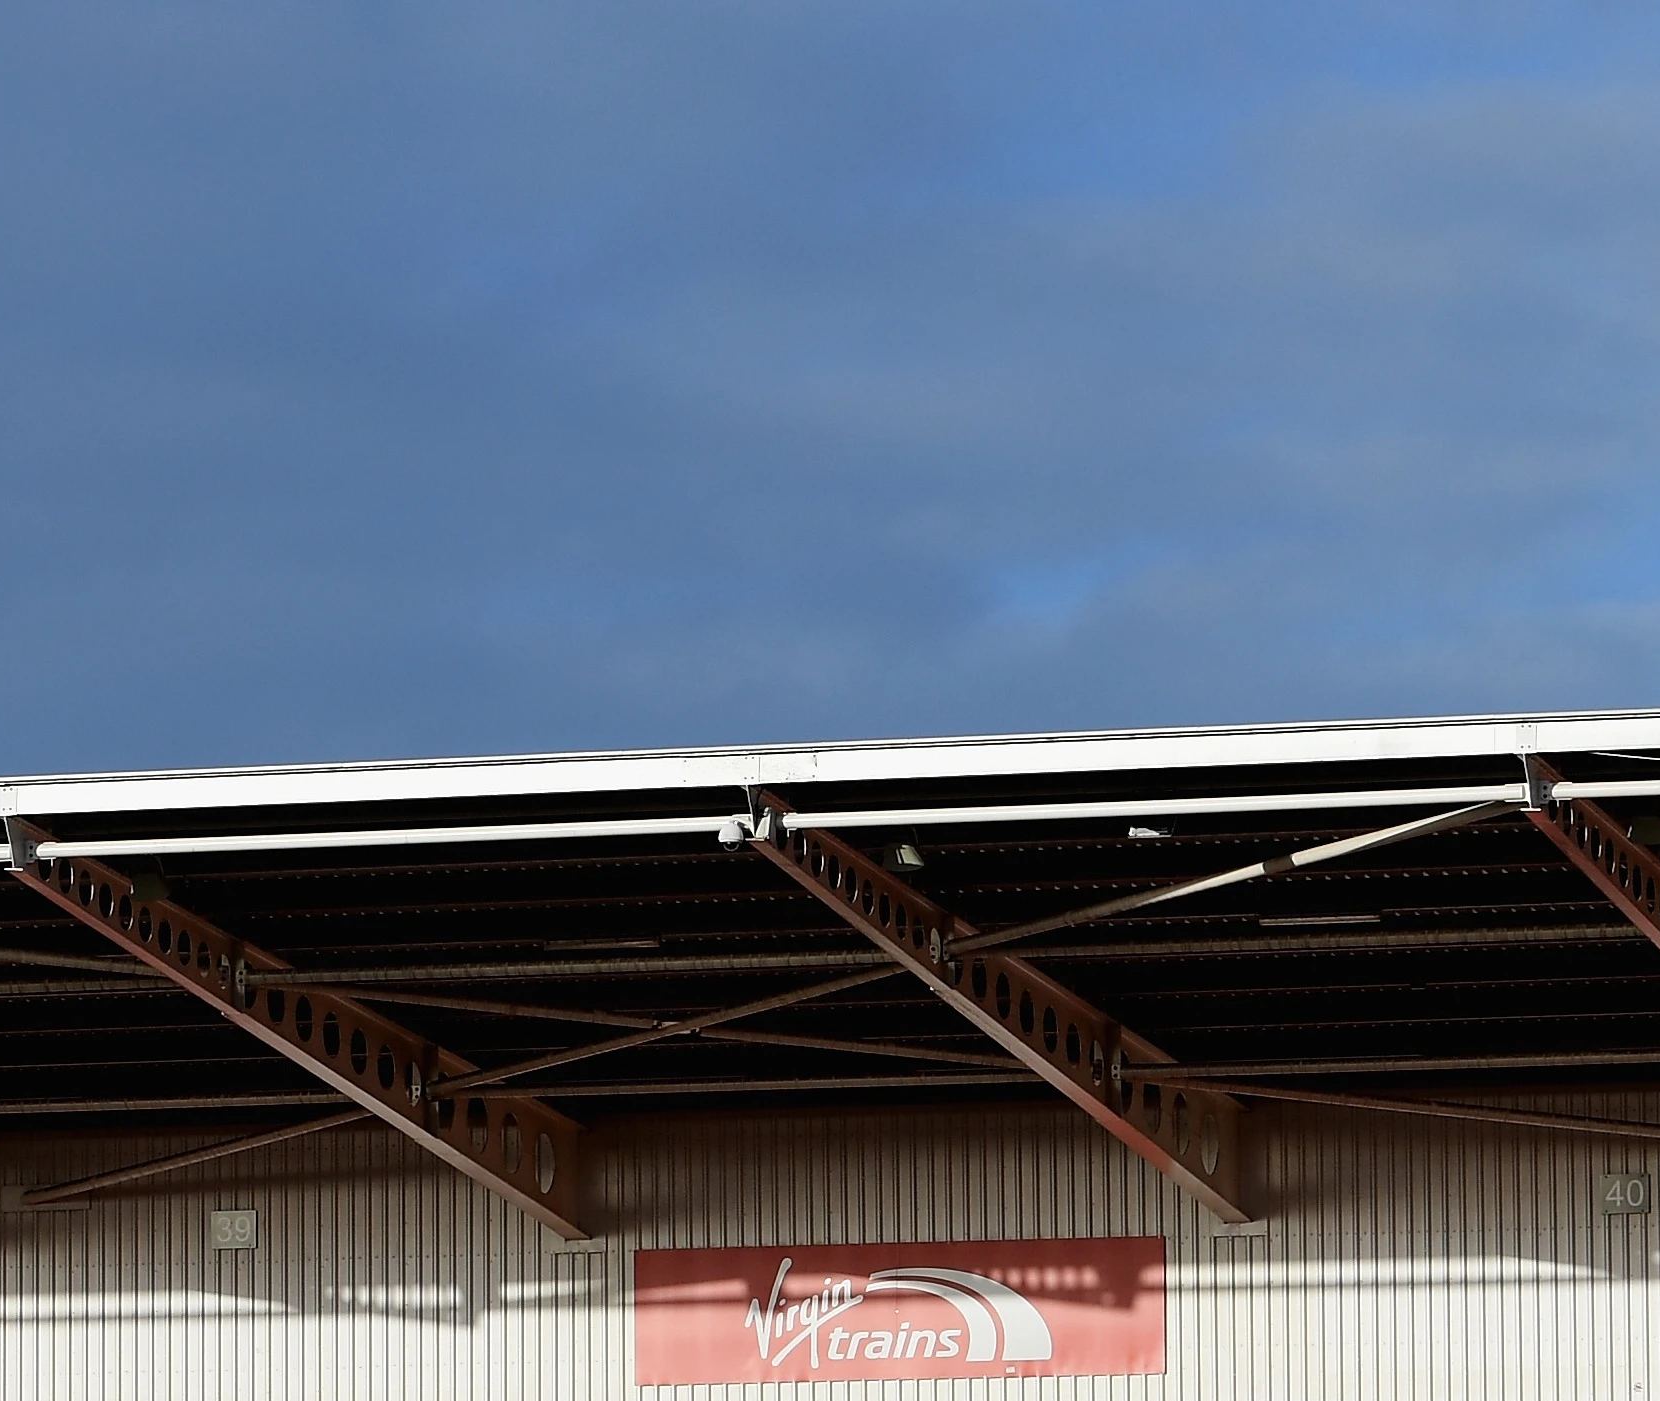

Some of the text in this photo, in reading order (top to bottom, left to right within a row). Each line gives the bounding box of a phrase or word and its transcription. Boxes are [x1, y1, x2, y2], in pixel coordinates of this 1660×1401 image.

[1605, 1181, 1646, 1208] 40
[217, 1216, 250, 1242] 39
[744, 1257, 864, 1369] Virgin
[827, 1321, 962, 1360] trains
